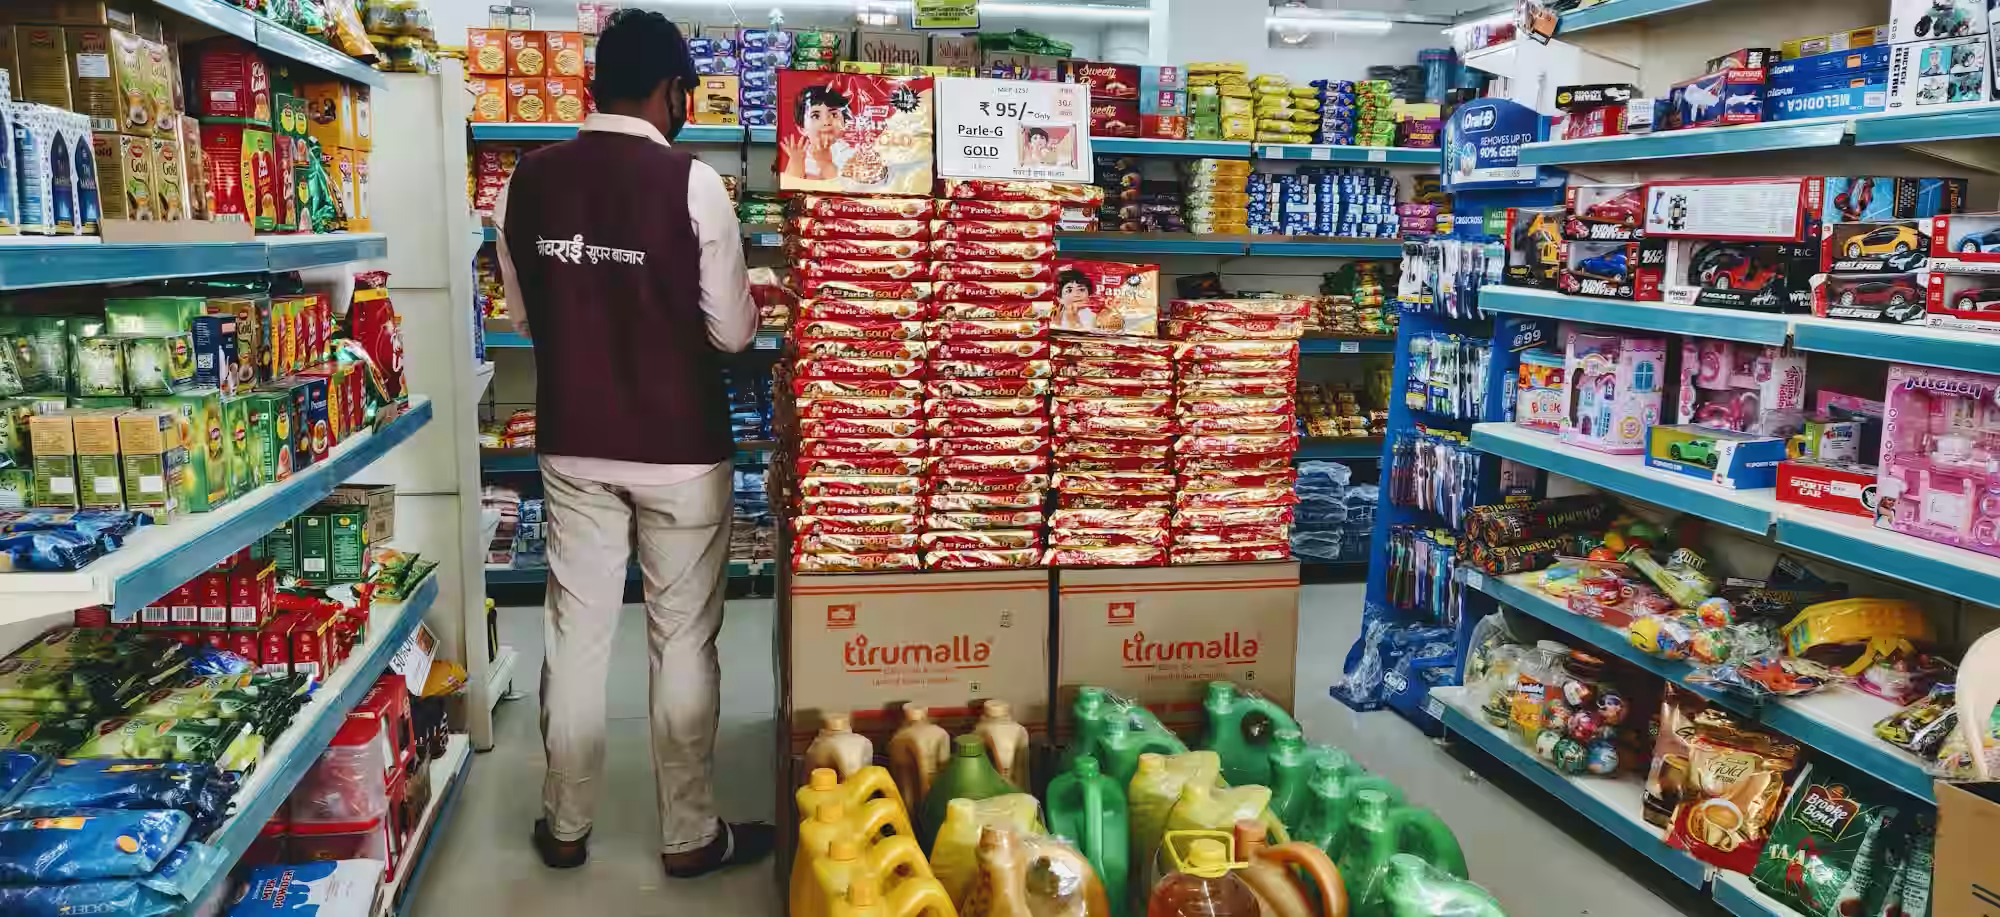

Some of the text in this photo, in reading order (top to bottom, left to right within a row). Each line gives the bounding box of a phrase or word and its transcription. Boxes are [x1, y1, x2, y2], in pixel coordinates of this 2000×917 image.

[1891, 47, 1903, 97] ELECTRIC
[1787, 94, 1850, 112] MELODICA
[995, 102, 1034, 121] 95/-
[1464, 110, 1495, 130] Oral-B
[958, 124, 1003, 137] Parle-G
[1480, 133, 1532, 146] REMOVES UP TO
[963, 145, 999, 157] GOLD
[1480, 146, 1498, 158] 90%
[131, 158, 148, 173] Gold
[162, 160, 178, 176] Gold
[970, 206, 1001, 214] Parle-G
[966, 227, 996, 235] Parle-G
[1590, 223, 1622, 232] KING
[1591, 230, 1632, 240] DRIVER
[585, 244, 611, 265] सुपर
[611, 248, 647, 266] बाजार
[964, 248, 995, 256] Parle-G
[1793, 248, 1812, 257] R/C
[1580, 278, 1612, 288] KING
[843, 289, 900, 299] Parle-G GOLD
[966, 288, 996, 296] Parle-G
[1581, 286, 1618, 296] DRIVER
[834, 307, 866, 316] Parle-G
[236, 321, 254, 335] Gold
[1520, 322, 1537, 332] Buy
[865, 330, 890, 339] GOLD
[1513, 329, 1542, 347] @99
[869, 349, 894, 358] GOLD
[864, 388, 889, 397] GOLD
[1905, 375, 1982, 400] Kitchen
[1777, 384, 1788, 410] appy
[832, 406, 864, 414] Parle-G
[957, 406, 987, 414] Parle-G
[834, 426, 866, 434] Parle-G
[836, 445, 867, 454] Parle-G
[962, 444, 992, 452] Parle-G
[867, 466, 891, 475] GOLD
[958, 463, 988, 471] Parle-G
[991, 484, 1015, 492] GOLD
[1790, 478, 1832, 493] SPORTS
[839, 487, 894, 496] Parle-G GOLD
[1799, 487, 1822, 498] CAR
[837, 507, 893, 515] Parle-G GOLD
[833, 525, 889, 533] Parle-G GOLD
[955, 542, 985, 550] Parle-G
[1510, 538, 1557, 557] Chameli
[844, 633, 991, 667] tirumalla
[1121, 630, 1260, 663] tirumalla
[1710, 758, 1750, 780] Gold
[1806, 792, 1849, 820] Brooke
[1803, 804, 1837, 829] Bond
[261, 878, 277, 901] MILK
[272, 869, 295, 909] POWDER
